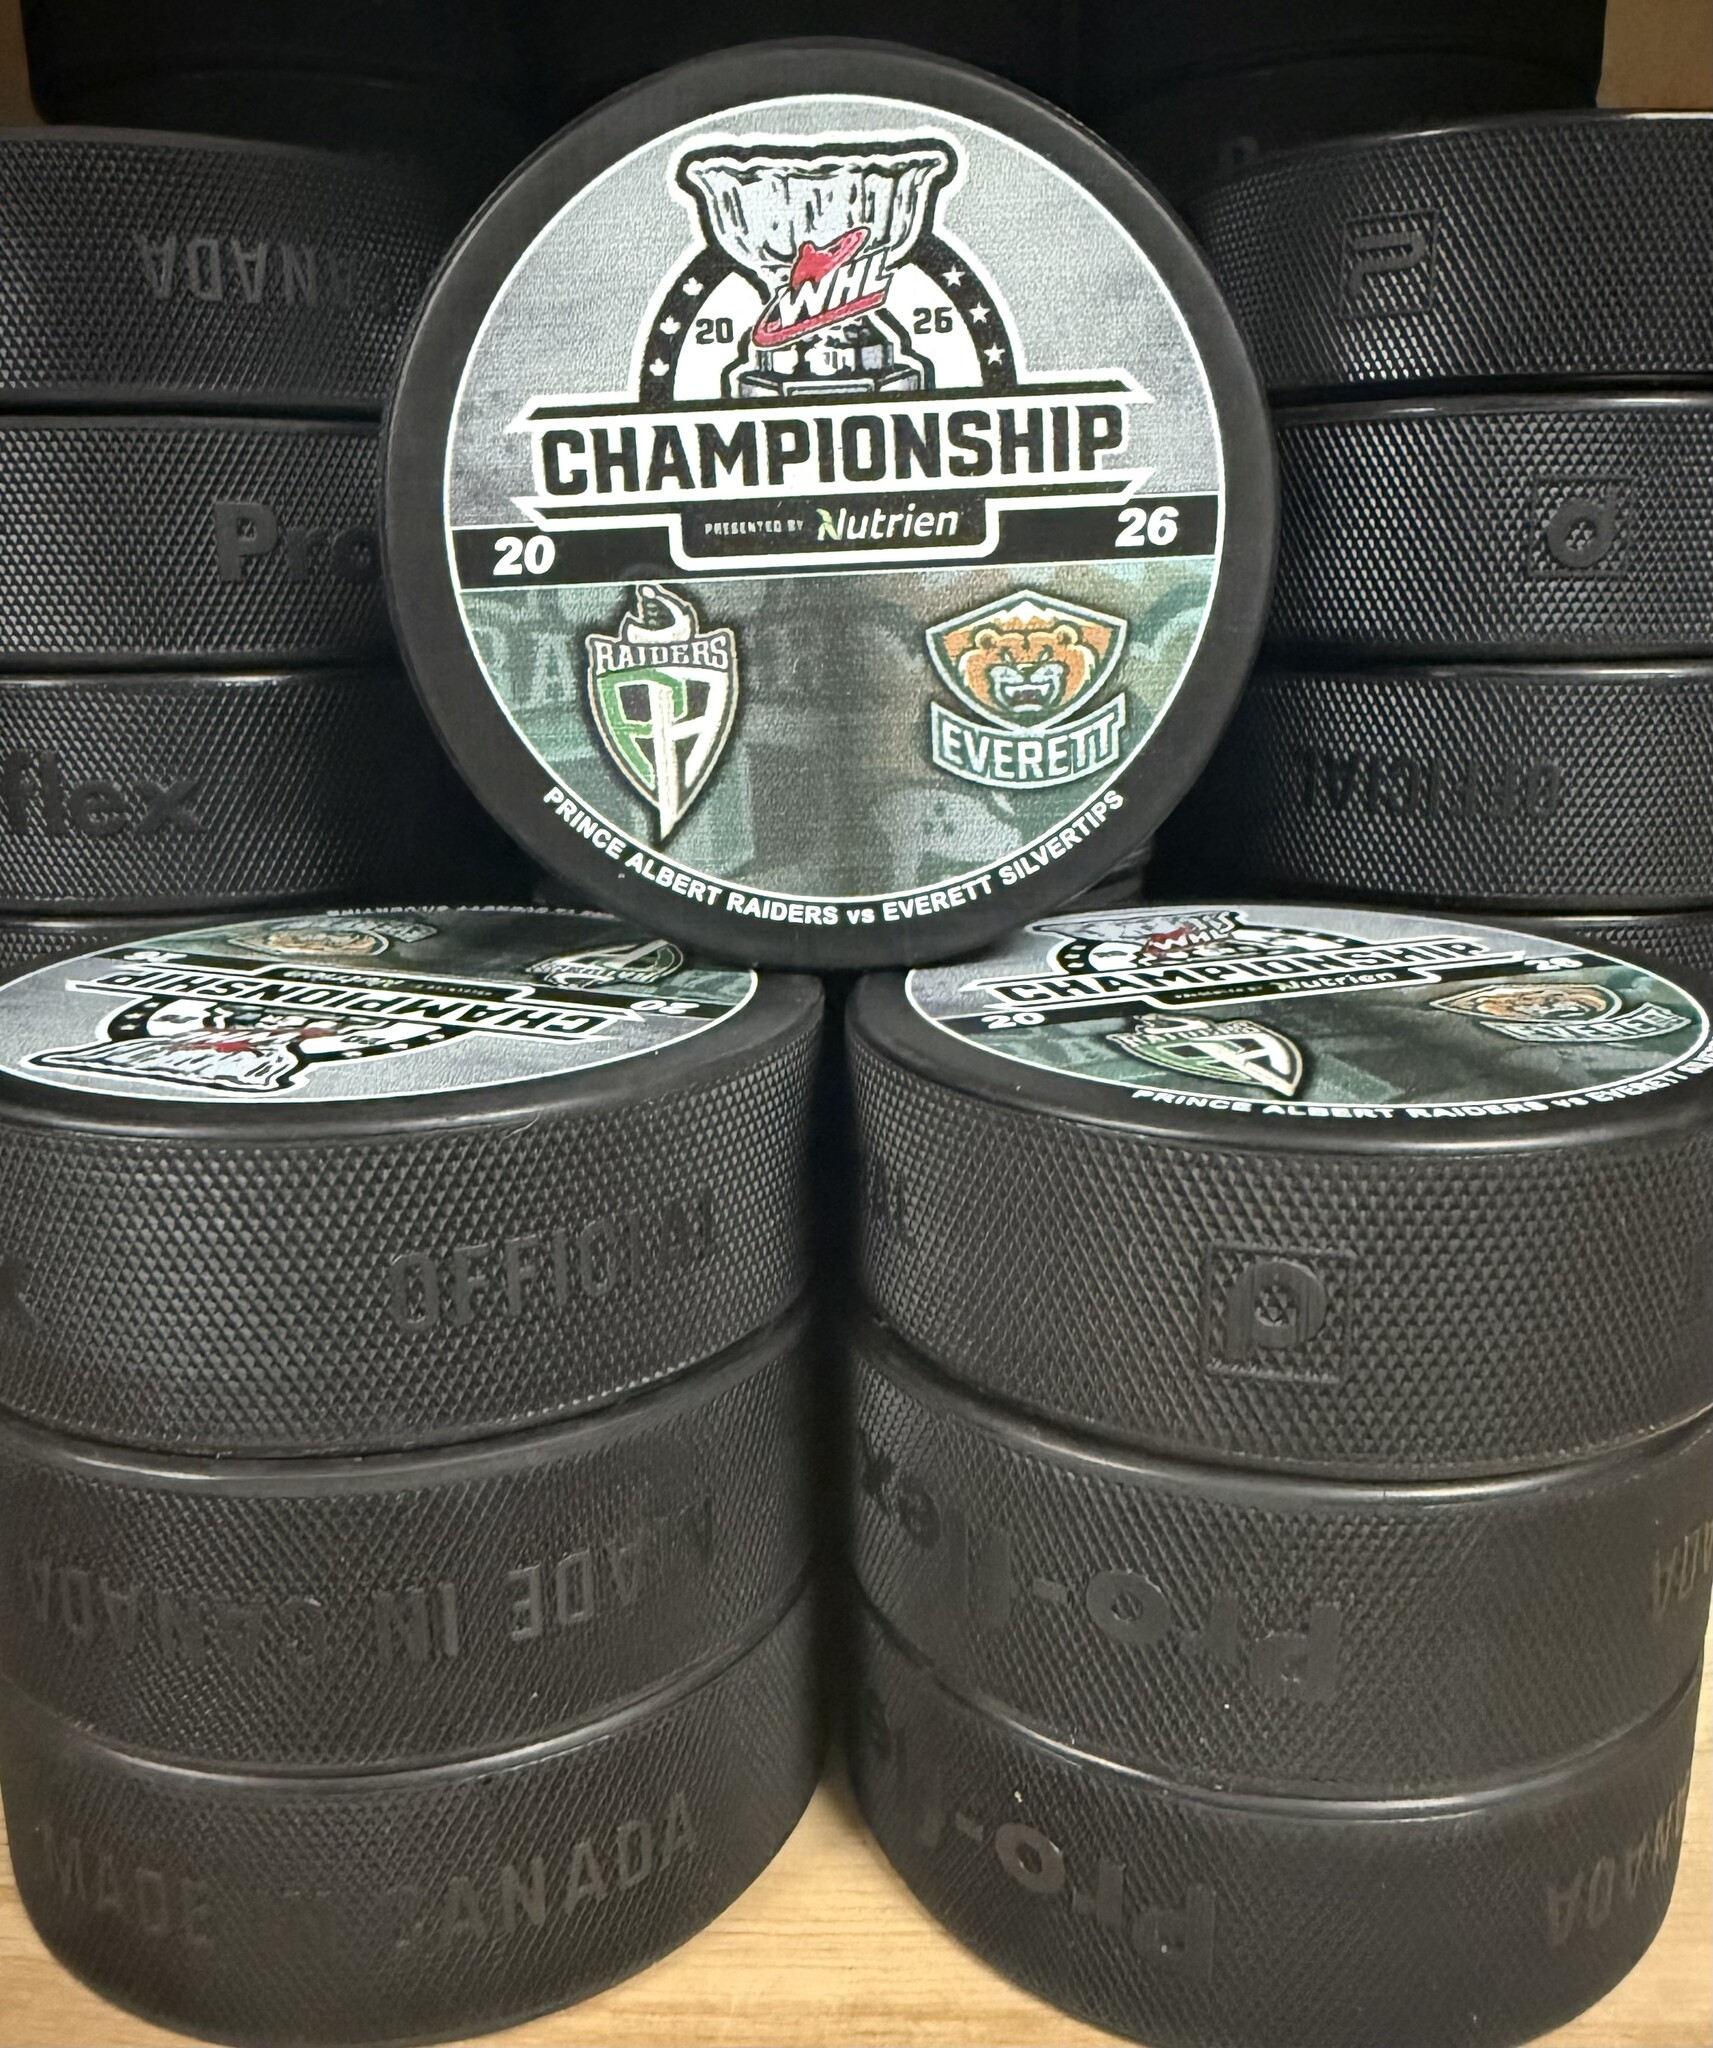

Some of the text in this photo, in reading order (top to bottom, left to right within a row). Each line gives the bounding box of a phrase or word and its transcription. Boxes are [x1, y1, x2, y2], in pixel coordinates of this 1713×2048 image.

[776, 247, 896, 327] WHL
[695, 318, 734, 344] 20
[912, 307, 953, 334] 26
[541, 404, 1125, 496] CHAMPIONSHIP
[705, 503, 959, 541] PRESENTED BY Nutrien
[1116, 507, 1179, 549] 26
[493, 535, 556, 576] 20
[596, 635, 729, 675] RAIDERS
[941, 712, 1115, 781] EVERETT
[543, 786, 627, 860] PRINCE
[625, 852, 722, 906] ALBERT
[726, 891, 839, 926] RAIDERS
[882, 874, 992, 922] EVERETT
[998, 790, 1124, 887] SILVERTIPS
[994, 940, 1486, 1002] CHAMPIONSHIP
[1269, 969, 1398, 992] Nutrien
[1524, 957, 1584, 971] 26
[97, 970, 606, 1035] CHAMPIONSHIP
[630, 999, 699, 1014] 20
[981, 1012, 1046, 1029] 20
[1132, 1090, 1252, 1112] PRINCE
[1262, 1101, 1393, 1119] ALBERT
[1410, 1099, 1551, 1119] RAIDERS
